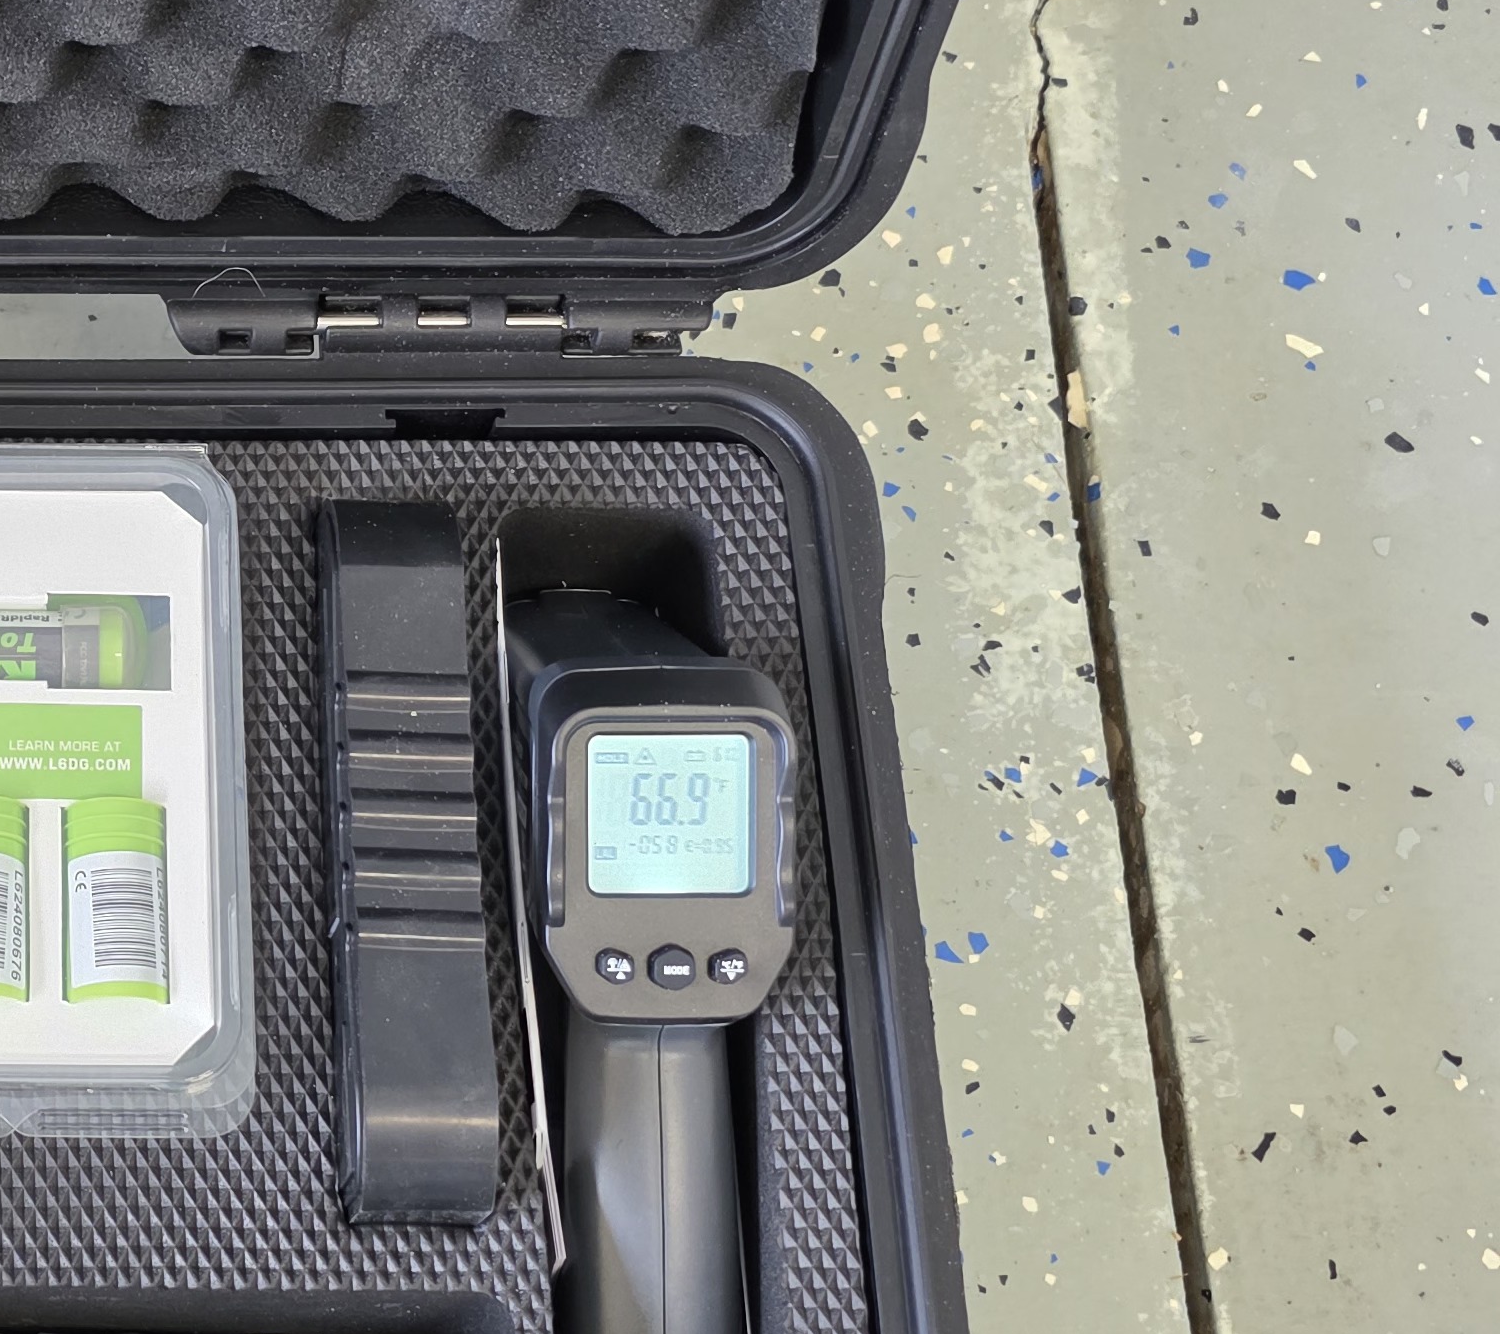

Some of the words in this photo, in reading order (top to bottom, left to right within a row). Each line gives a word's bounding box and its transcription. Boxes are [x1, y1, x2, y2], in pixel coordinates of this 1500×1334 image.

[9, 739, 54, 751] LEARN
[59, 740, 99, 752] MORE
[103, 741, 121, 752] AT
[629, 772, 711, 826] 66.9
[11, 870, 23, 982] L624080676
[663, 965, 690, 976] MODE
